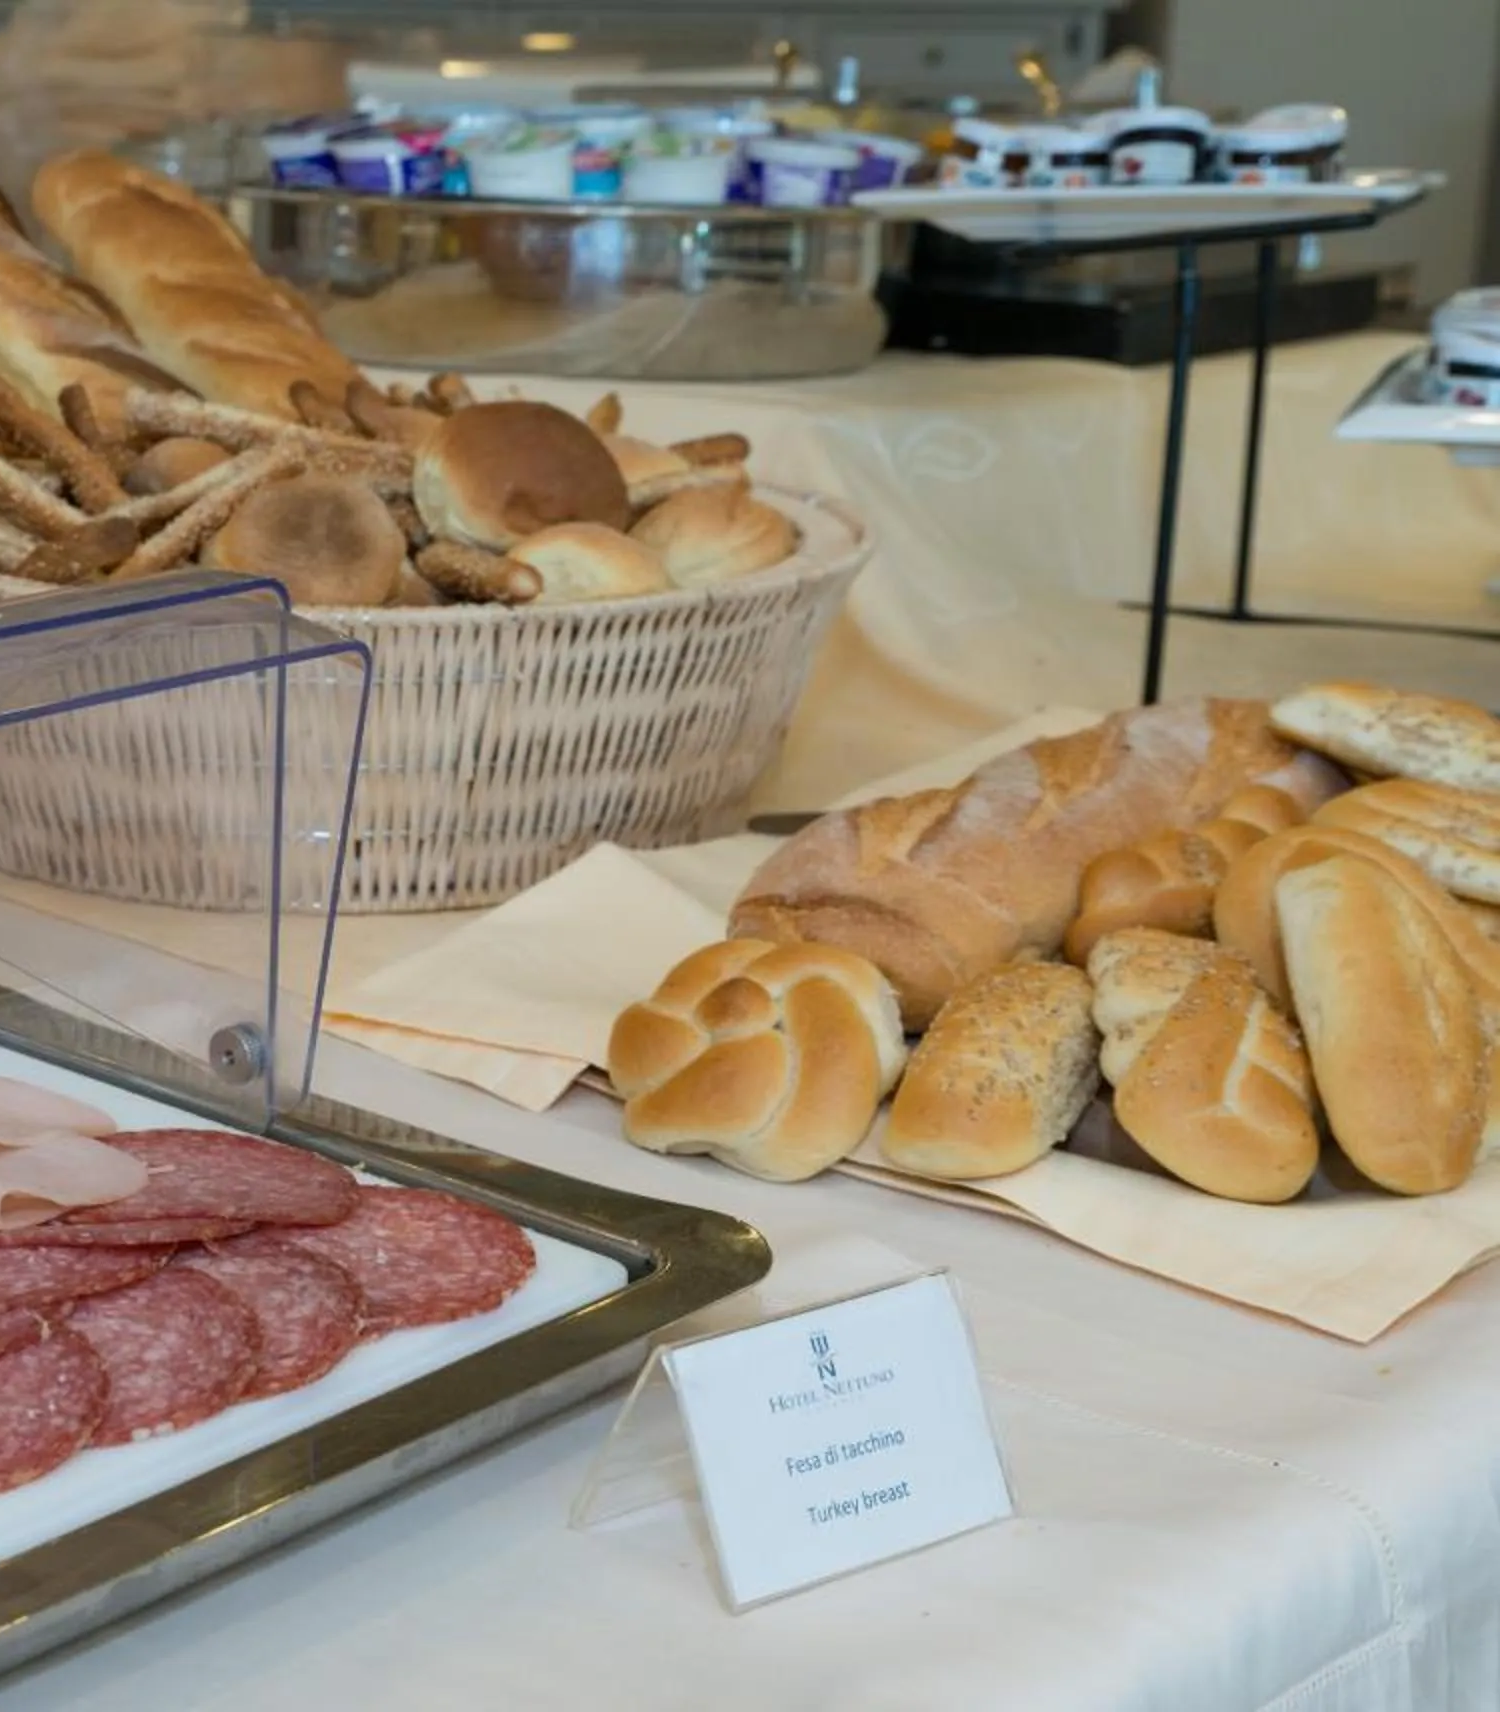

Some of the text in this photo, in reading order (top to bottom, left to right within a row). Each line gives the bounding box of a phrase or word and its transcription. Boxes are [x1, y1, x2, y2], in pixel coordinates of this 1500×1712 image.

[785, 1429, 905, 1478] Fesa di tacchino
[806, 1481, 911, 1523] Turkey breast
